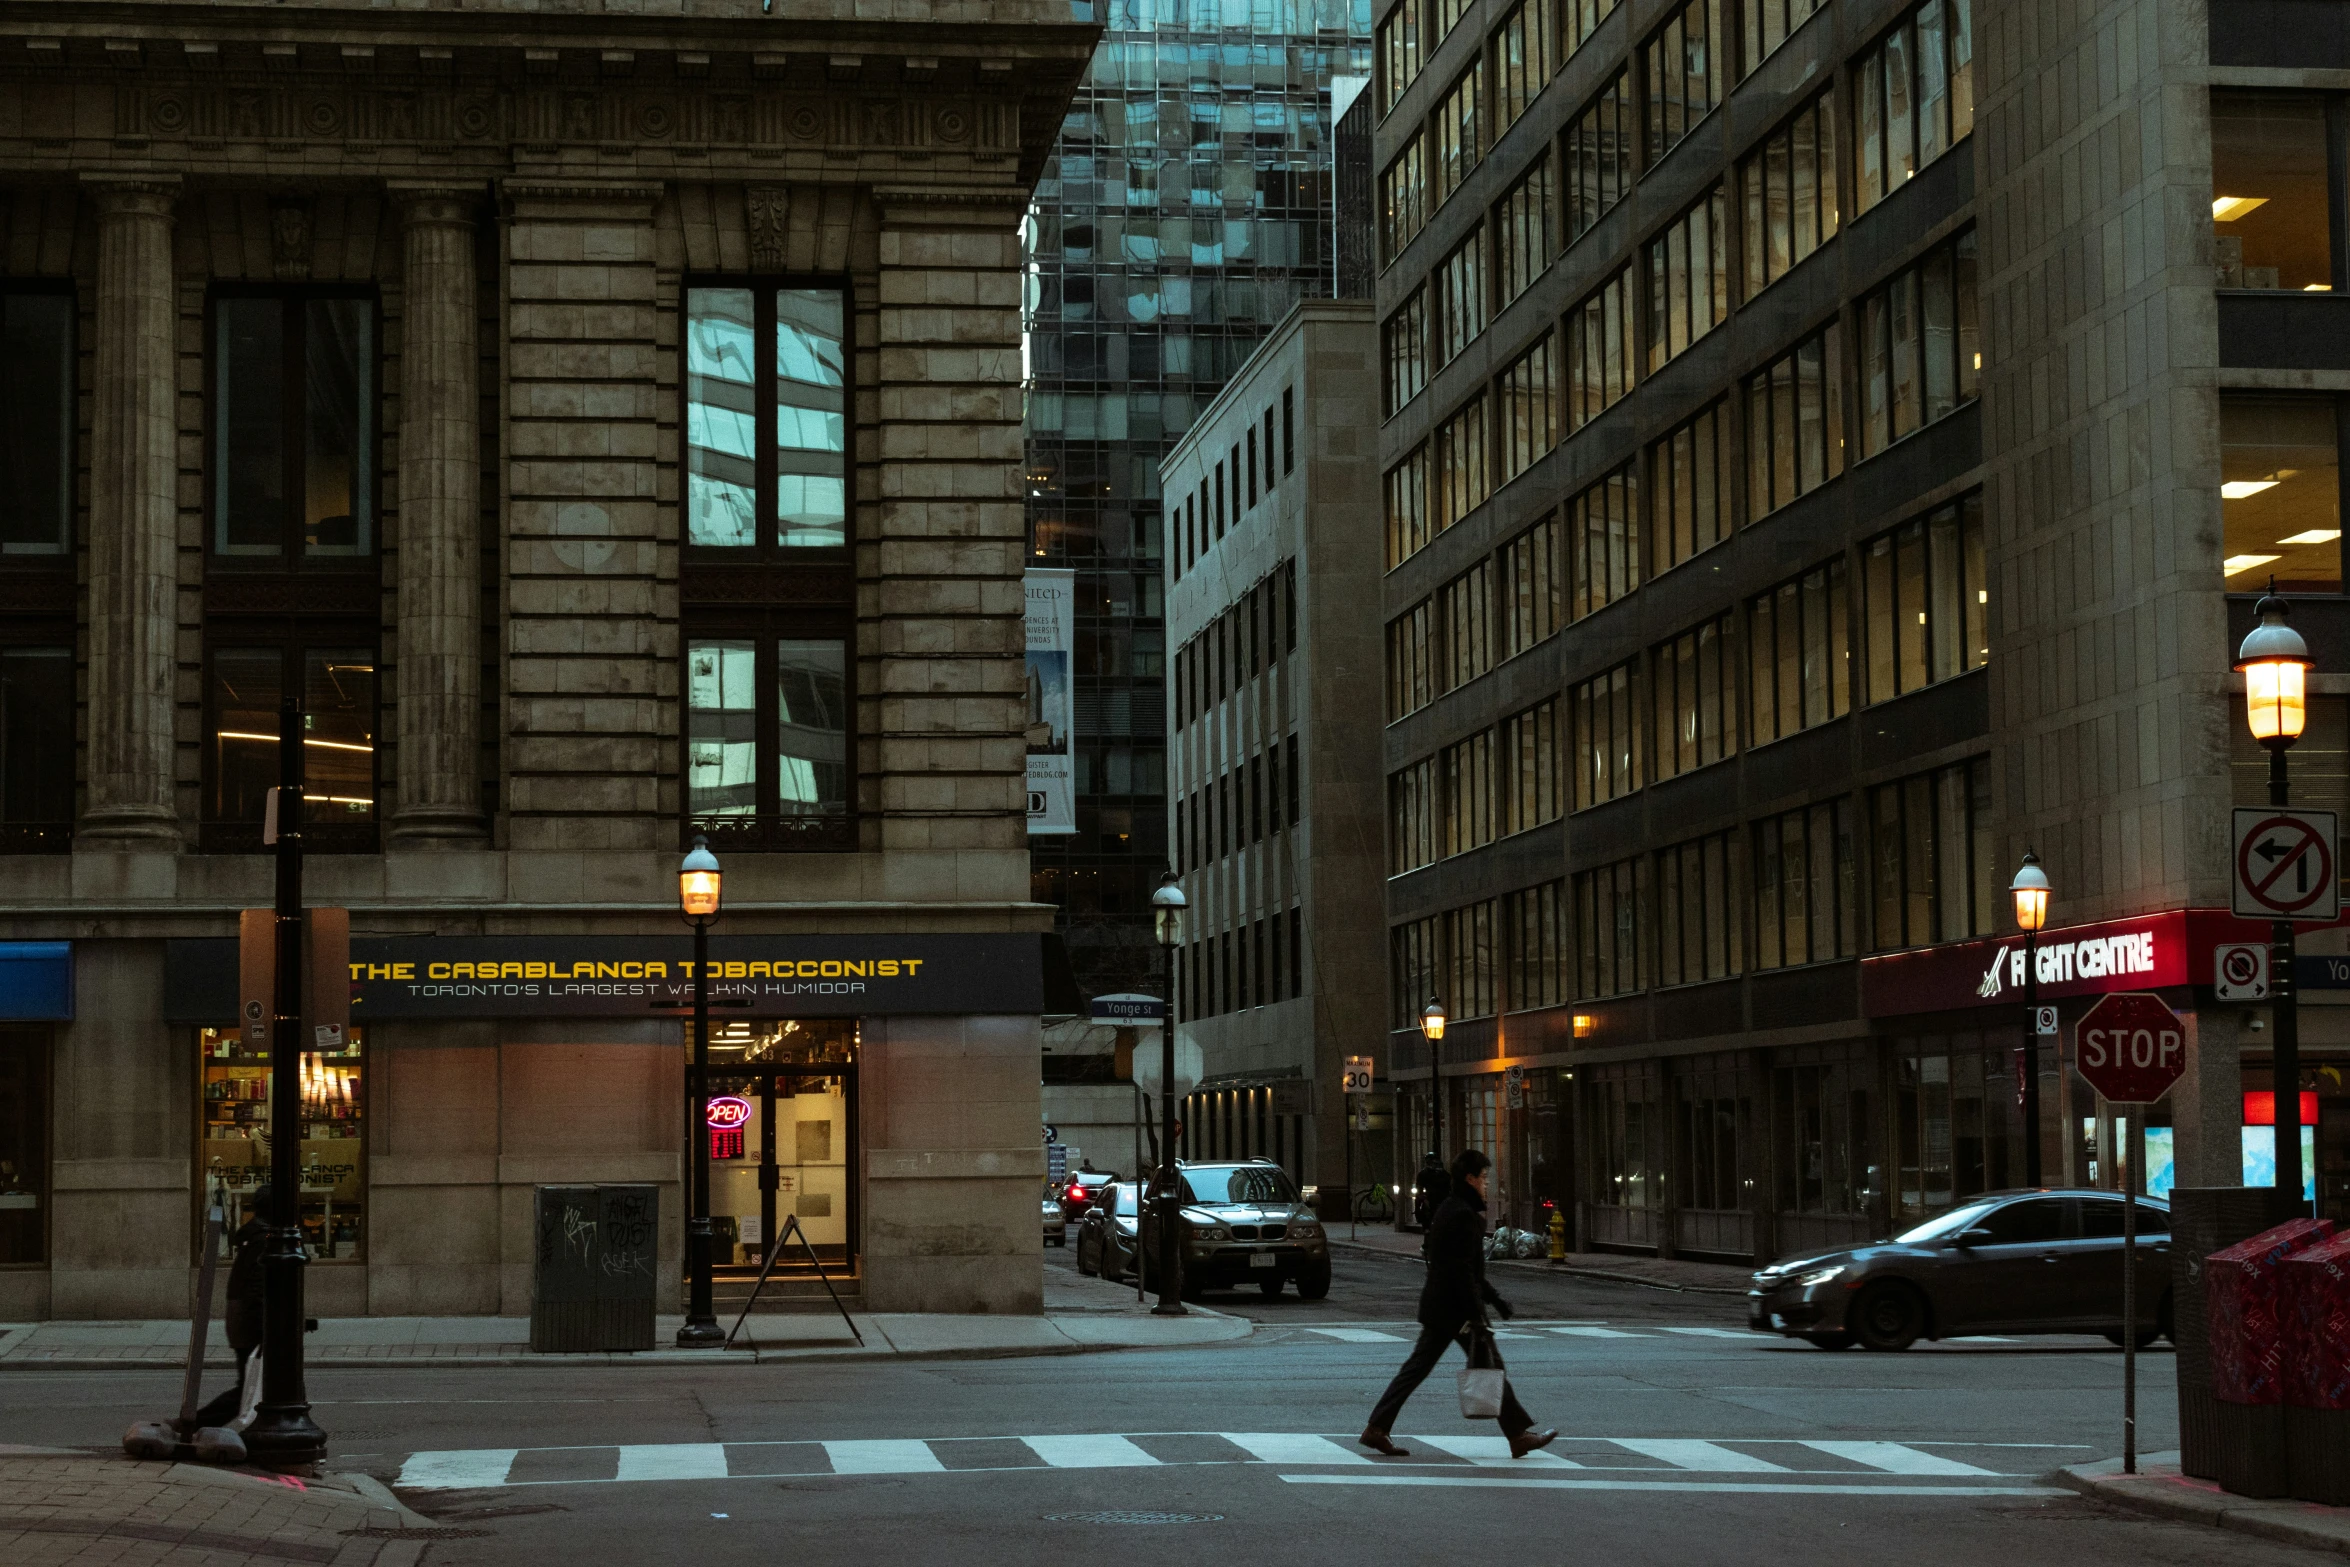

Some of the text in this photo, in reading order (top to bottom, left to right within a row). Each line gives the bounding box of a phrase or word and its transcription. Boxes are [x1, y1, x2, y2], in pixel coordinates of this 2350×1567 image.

[2076, 931, 2155, 978] CENTRE
[349, 959, 923, 980] THE CASABLANCA TOBACCONIST
[407, 984, 541, 997] TORONTO'S
[548, 983, 660, 996] LARGEST
[765, 982, 866, 995] HUMIDOR
[1107, 1002, 1152, 1017] Yonge St
[761, 1050, 775, 1061] 63
[2085, 1028, 2181, 1069] STOP
[1346, 1071, 1370, 1088] 30
[707, 1104, 746, 1121] OPEN
[207, 1166, 240, 1175] THE
